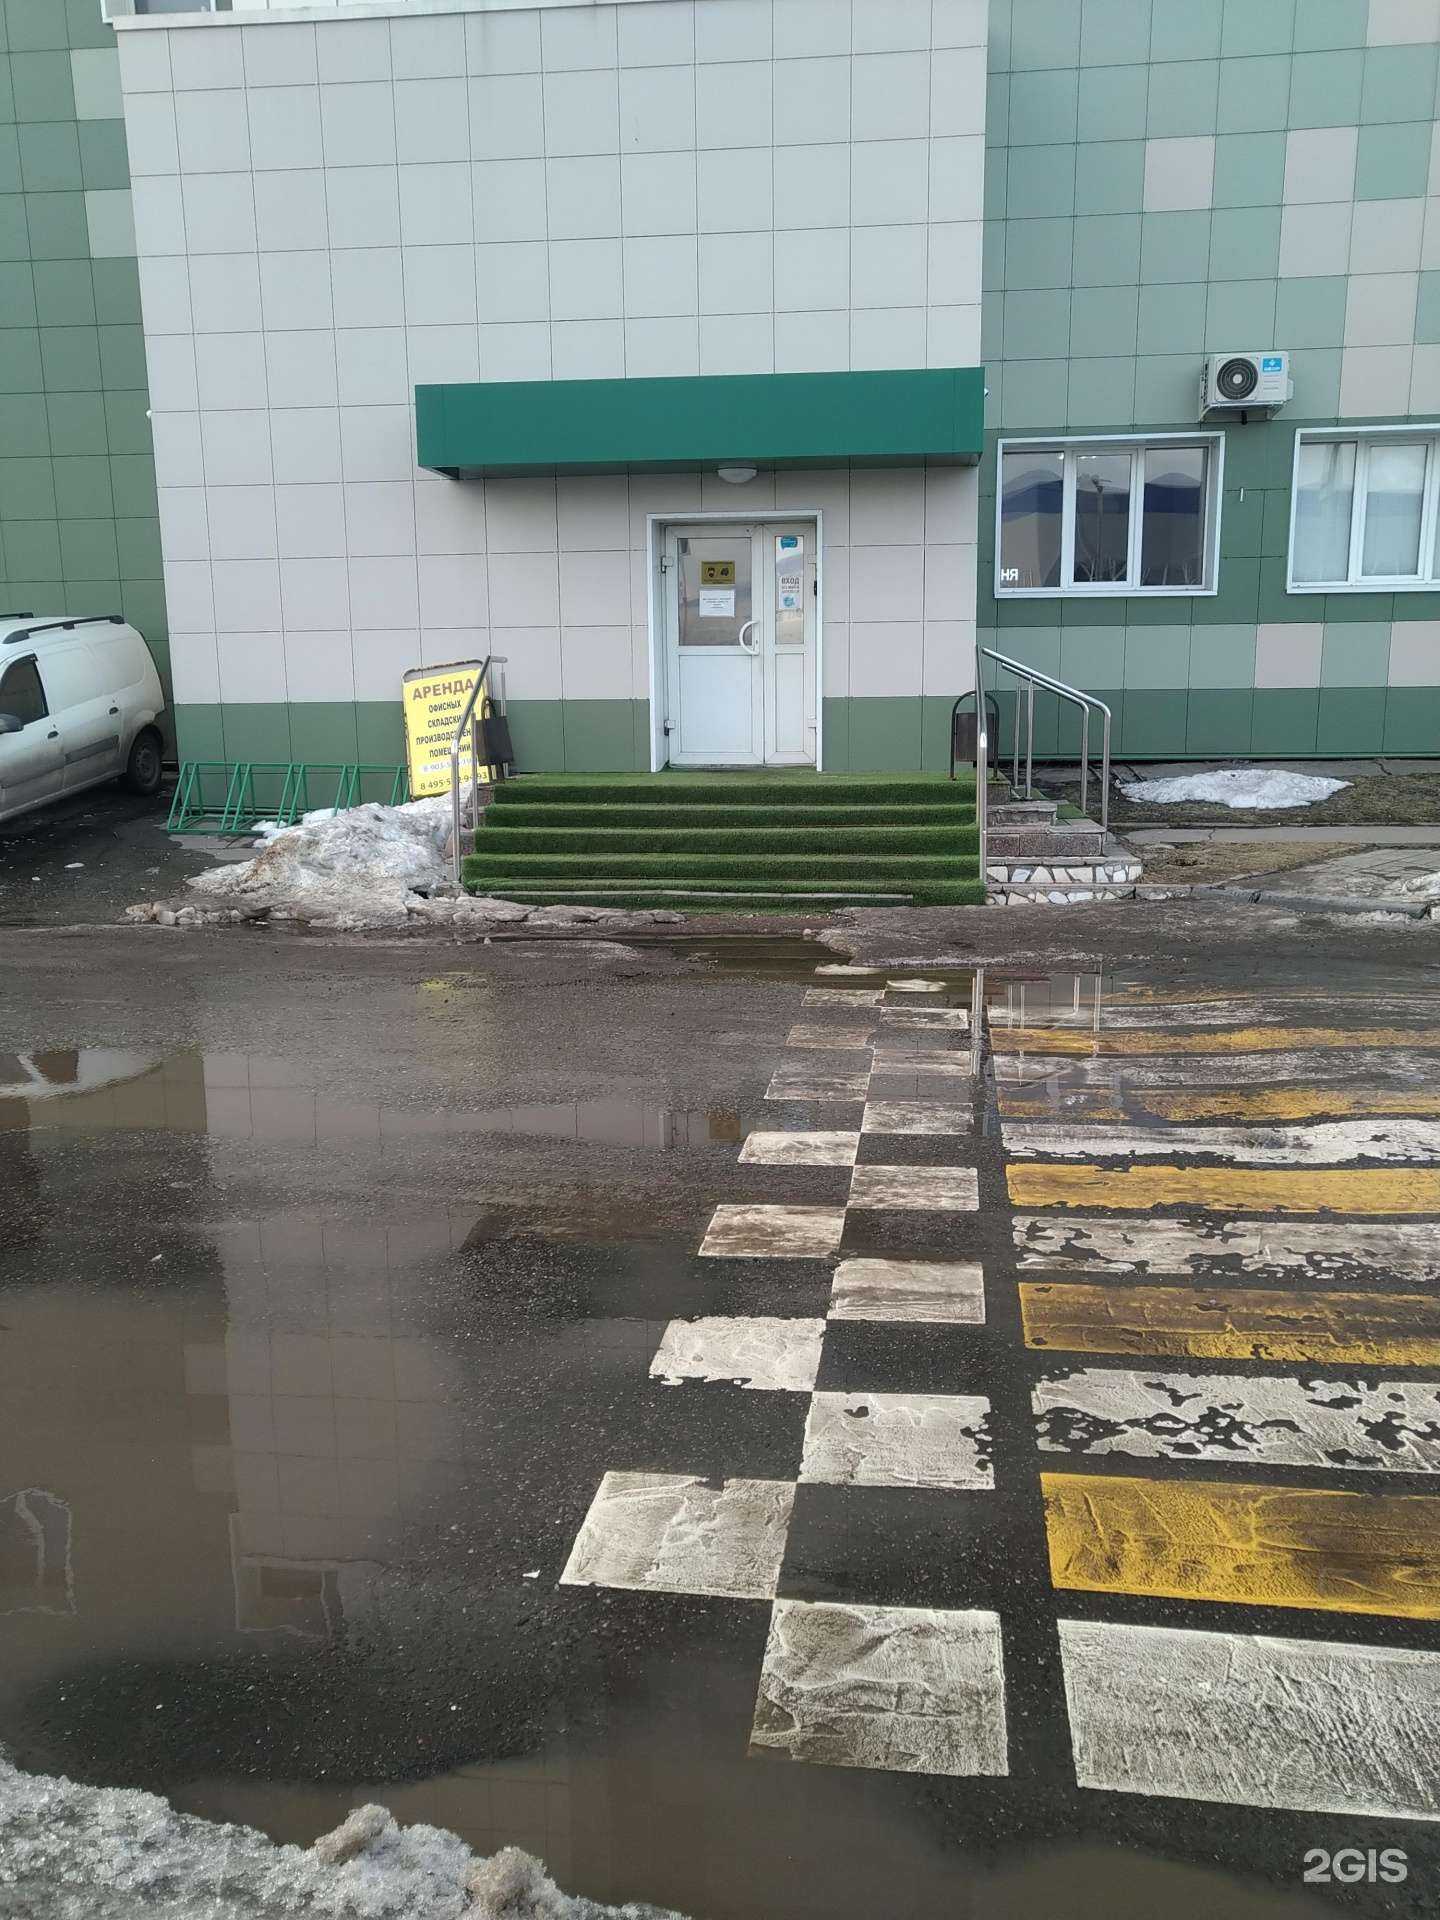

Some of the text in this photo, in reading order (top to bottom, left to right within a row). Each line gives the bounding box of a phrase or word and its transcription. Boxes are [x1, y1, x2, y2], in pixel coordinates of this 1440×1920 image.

[412, 678, 474, 700] АРЕНДА
[428, 699, 462, 713] ОФИСНЫХ
[427, 713, 464, 728] СКЛАДСКИ
